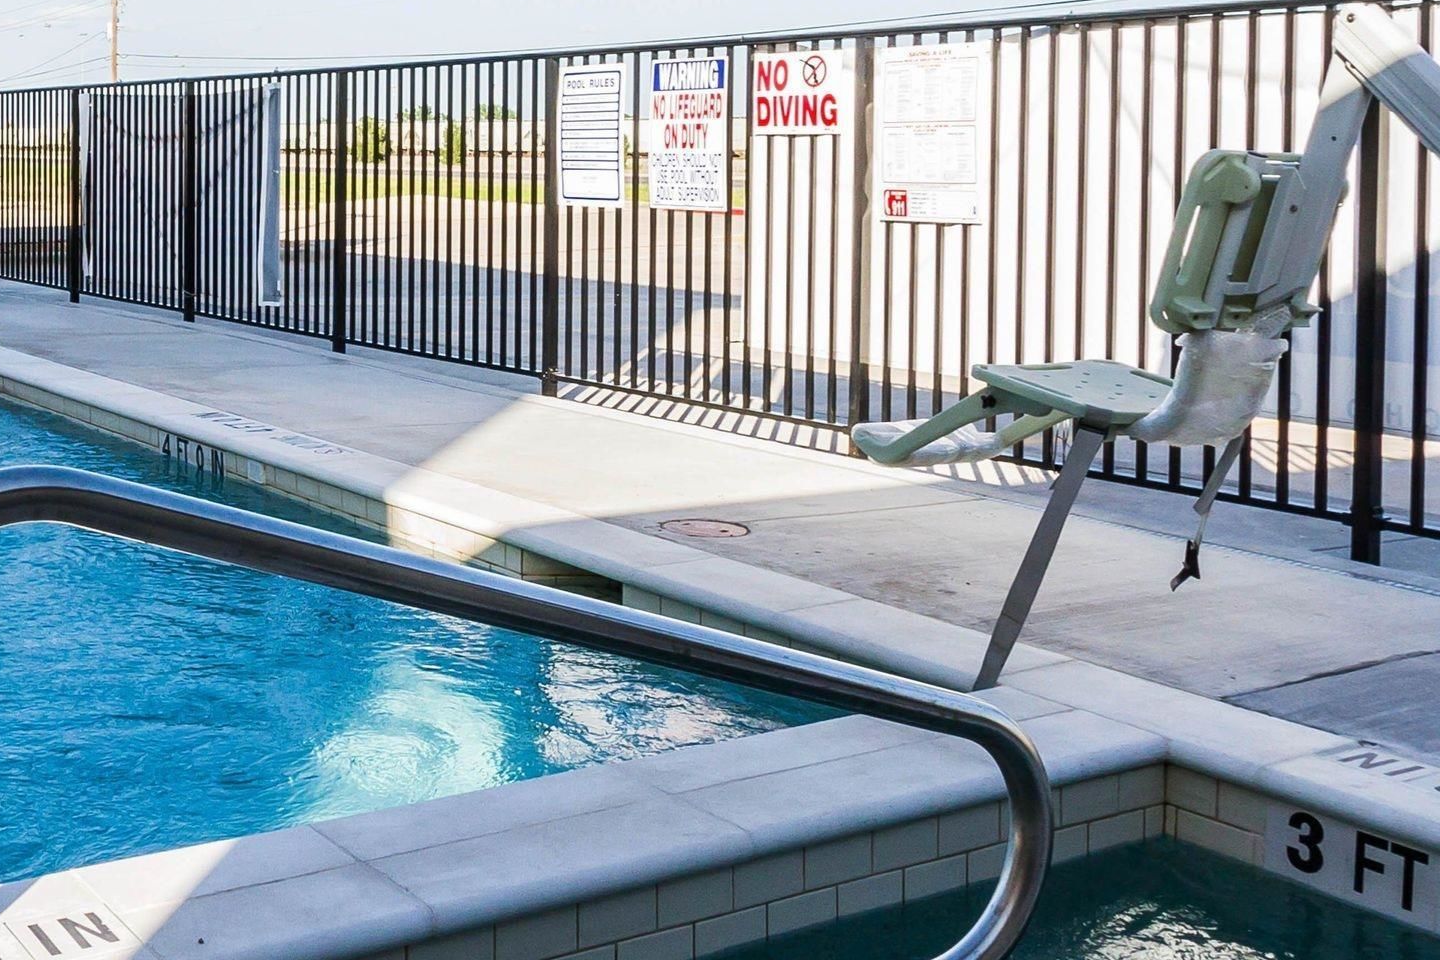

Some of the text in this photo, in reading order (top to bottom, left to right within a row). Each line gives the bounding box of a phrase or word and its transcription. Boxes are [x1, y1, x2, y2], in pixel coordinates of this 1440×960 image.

[567, 78, 615, 89] POOL RULES
[659, 60, 720, 91] WARNING
[757, 60, 788, 92] NO
[653, 93, 722, 120] NO LIFEGUARD
[757, 93, 838, 127] DIVING
[664, 123, 709, 149] ON DUTY
[892, 199, 905, 216] 911
[162, 433, 171, 456] 4
[177, 437, 189, 464] FT
[211, 449, 224, 476] IN
[1337, 752, 1425, 776] IN
[1286, 812, 1429, 913] 3 FT
[27, 912, 120, 956] IN
